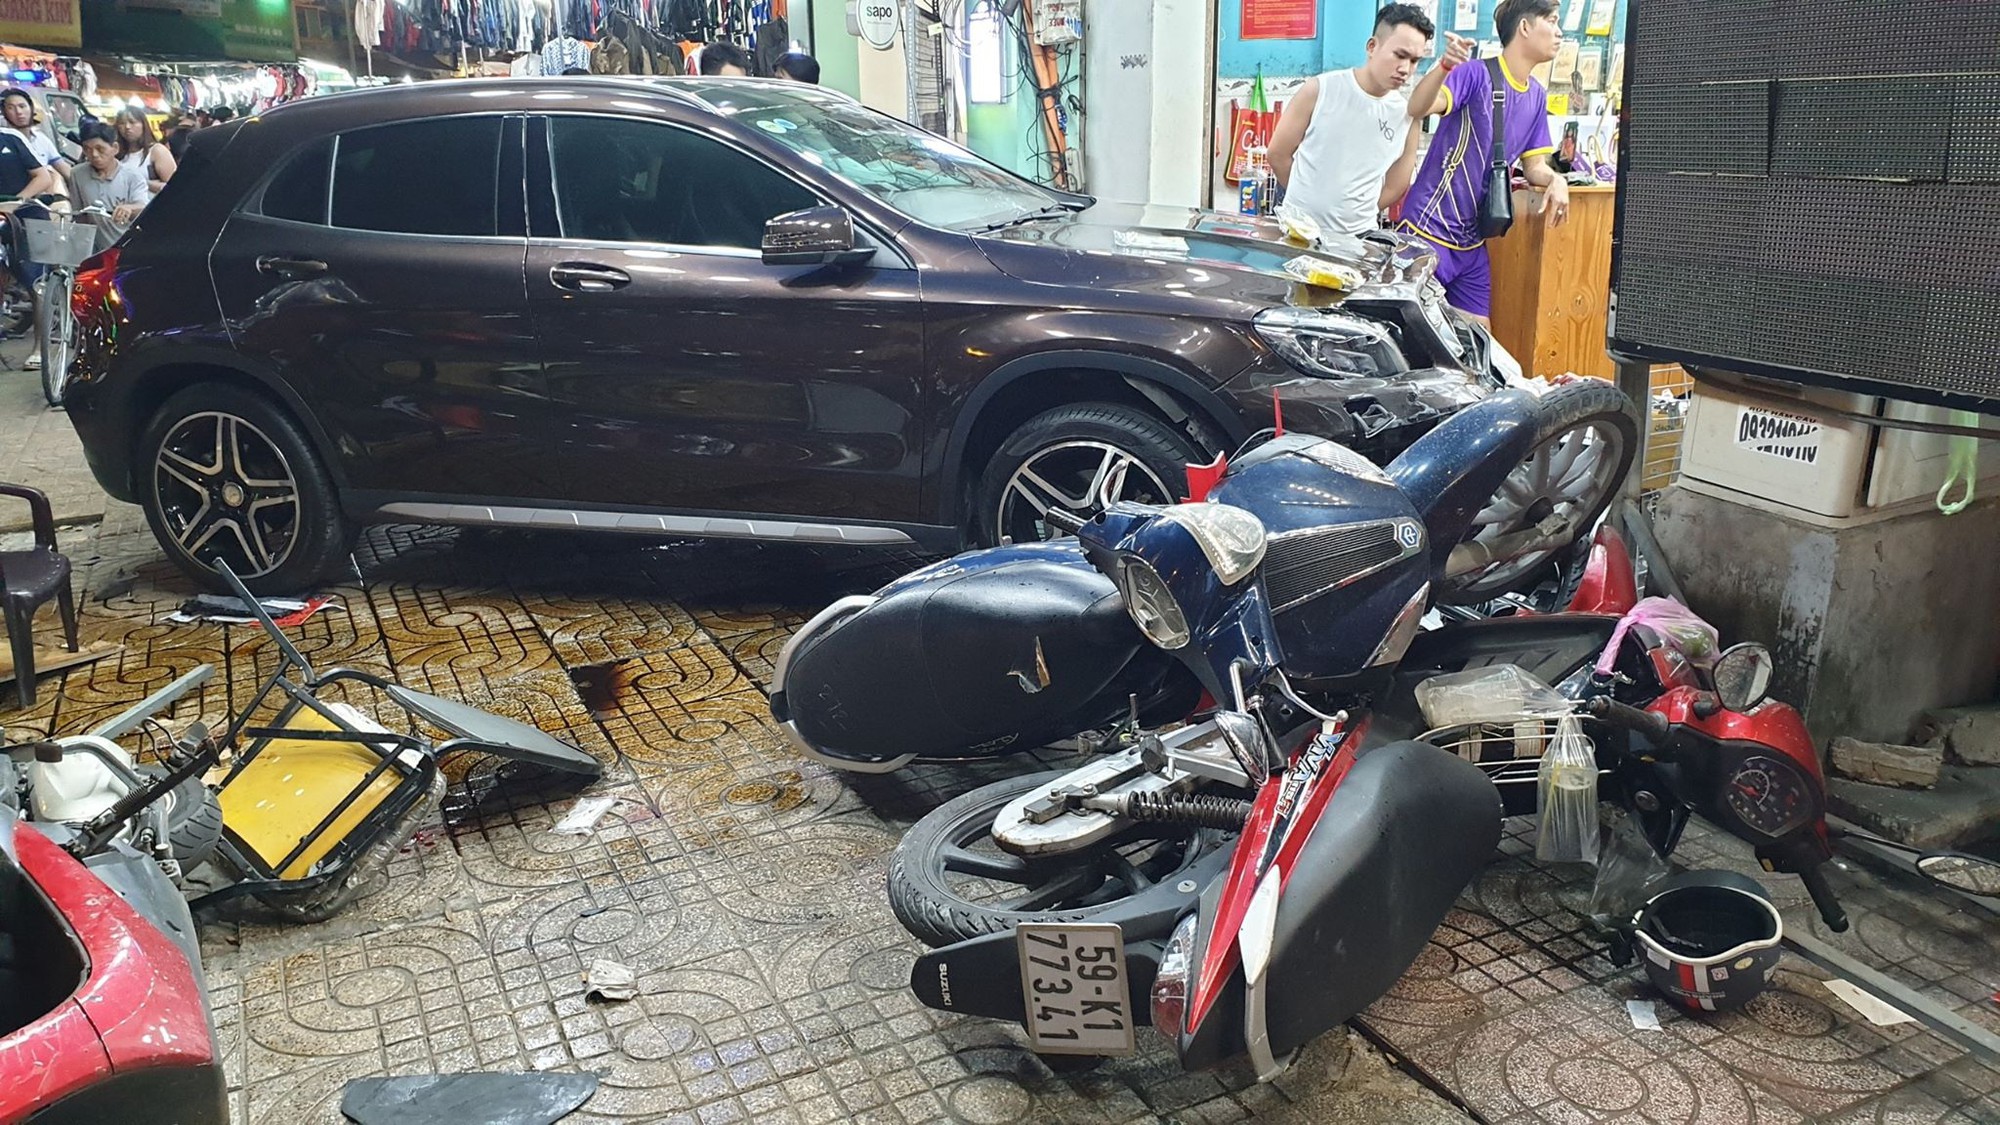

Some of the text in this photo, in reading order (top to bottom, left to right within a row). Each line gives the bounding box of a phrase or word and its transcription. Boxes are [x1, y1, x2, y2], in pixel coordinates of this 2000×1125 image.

[866, 6, 893, 21] sapo
[938, 962, 953, 1006] SUZUKI
[1026, 933, 1079, 1040] 773.41
[1075, 946, 1124, 1031] 59-K1
